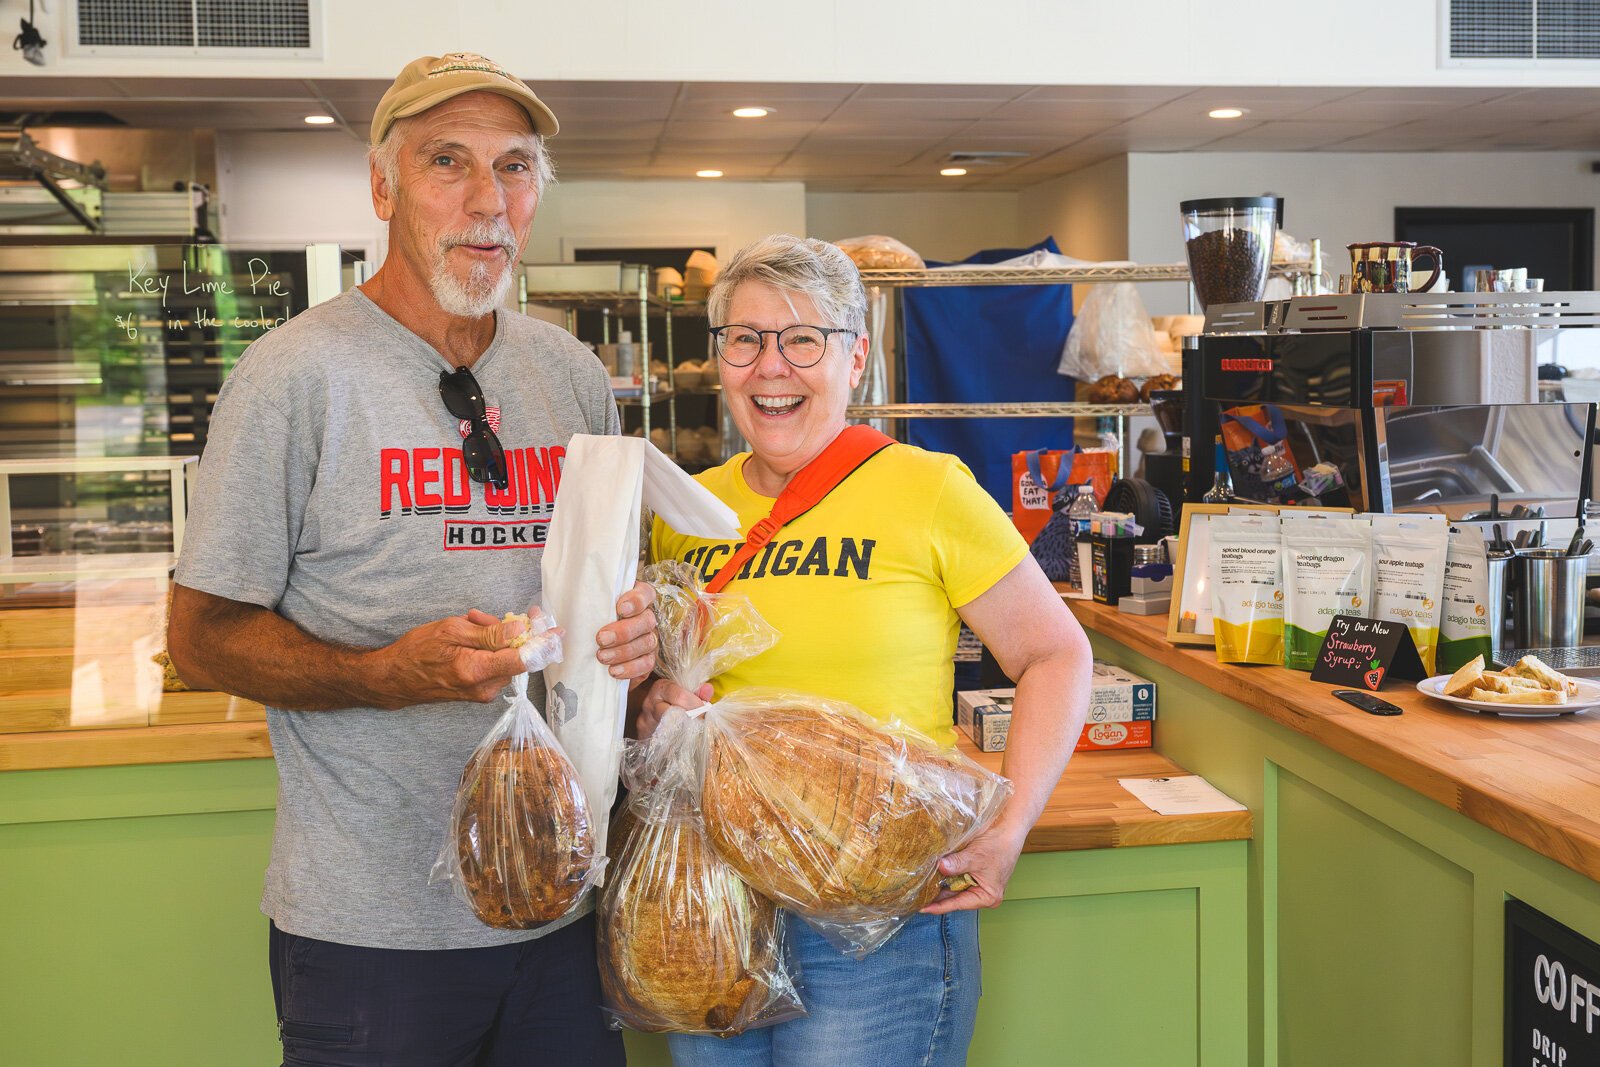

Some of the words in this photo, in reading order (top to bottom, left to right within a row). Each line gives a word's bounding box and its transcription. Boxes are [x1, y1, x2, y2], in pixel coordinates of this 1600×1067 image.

[127, 259, 170, 307] Key
[183, 260, 234, 295] Lime
[248, 258, 289, 297] Pie
[114, 312, 138, 340] $6
[168, 310, 184, 331] in
[194, 307, 223, 329] the
[380, 447, 472, 516] RED
[1023, 488, 1039, 496] EAT
[1022, 496, 1047, 506] THAT?
[449, 526, 547, 545] HOCKE
[1389, 560, 1404, 568] apple
[1267, 602, 1283, 610] teas
[1345, 608, 1362, 616] teas
[1390, 607, 1413, 618] adagio
[1415, 609, 1433, 619] teas
[1336, 619, 1350, 636] Try
[1354, 622, 1369, 632] Our
[1371, 621, 1390, 635] New
[1447, 615, 1469, 626] adagio
[1469, 617, 1486, 626] teas
[1327, 632, 1377, 661] Strawberry
[1323, 651, 1356, 669] Syrup
[1093, 729, 1124, 740] Logan
[1534, 954, 1600, 1034] COFF
[1532, 1028, 1567, 1067] DRIP
